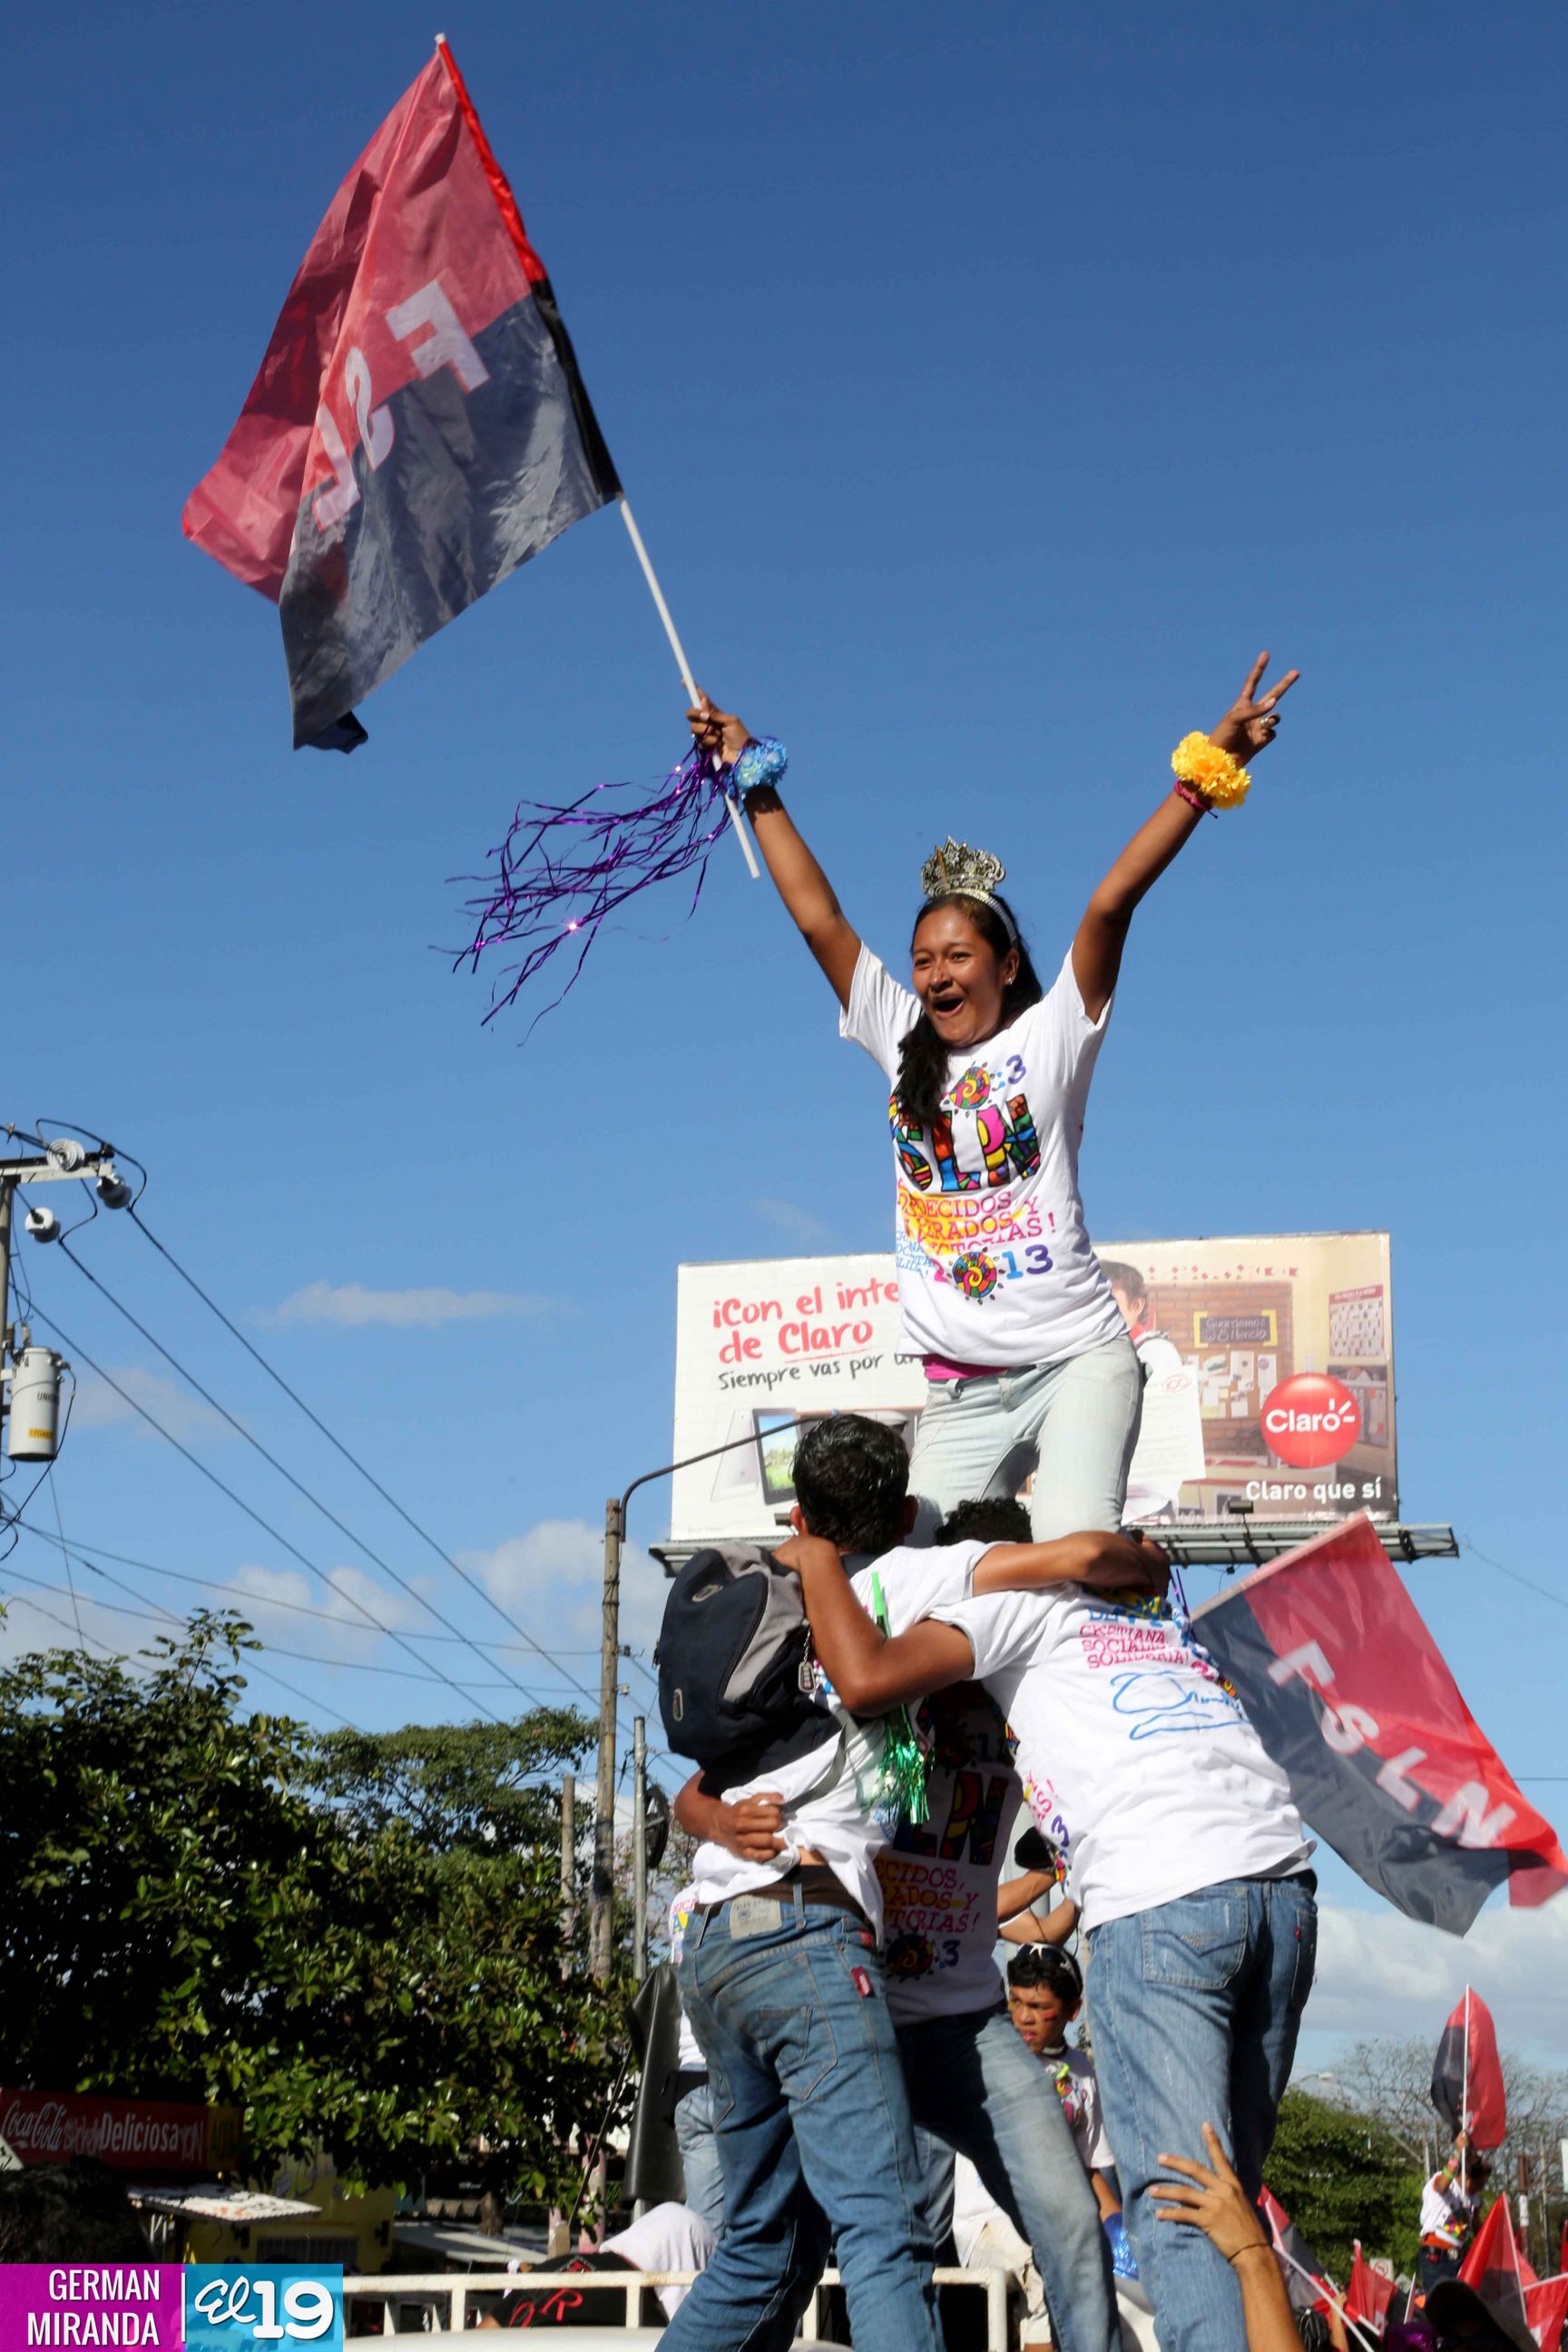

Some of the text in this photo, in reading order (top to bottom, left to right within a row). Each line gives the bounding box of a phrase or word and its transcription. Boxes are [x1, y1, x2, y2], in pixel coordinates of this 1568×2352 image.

[796, 1287, 823, 1316] el
[719, 1319, 874, 1365] de Claro
[718, 1367, 802, 1391] Siempre
[808, 1361, 842, 1377] vas
[848, 1354, 886, 1379] por
[1266, 1405, 1343, 1434] Claro
[1246, 1476, 1381, 1504] Claro que sí
[1268, 1640, 1517, 1849] FSLN
[2, 2099, 66, 2151] Coca-Cola
[100, 2111, 179, 2152] Deliciosa
